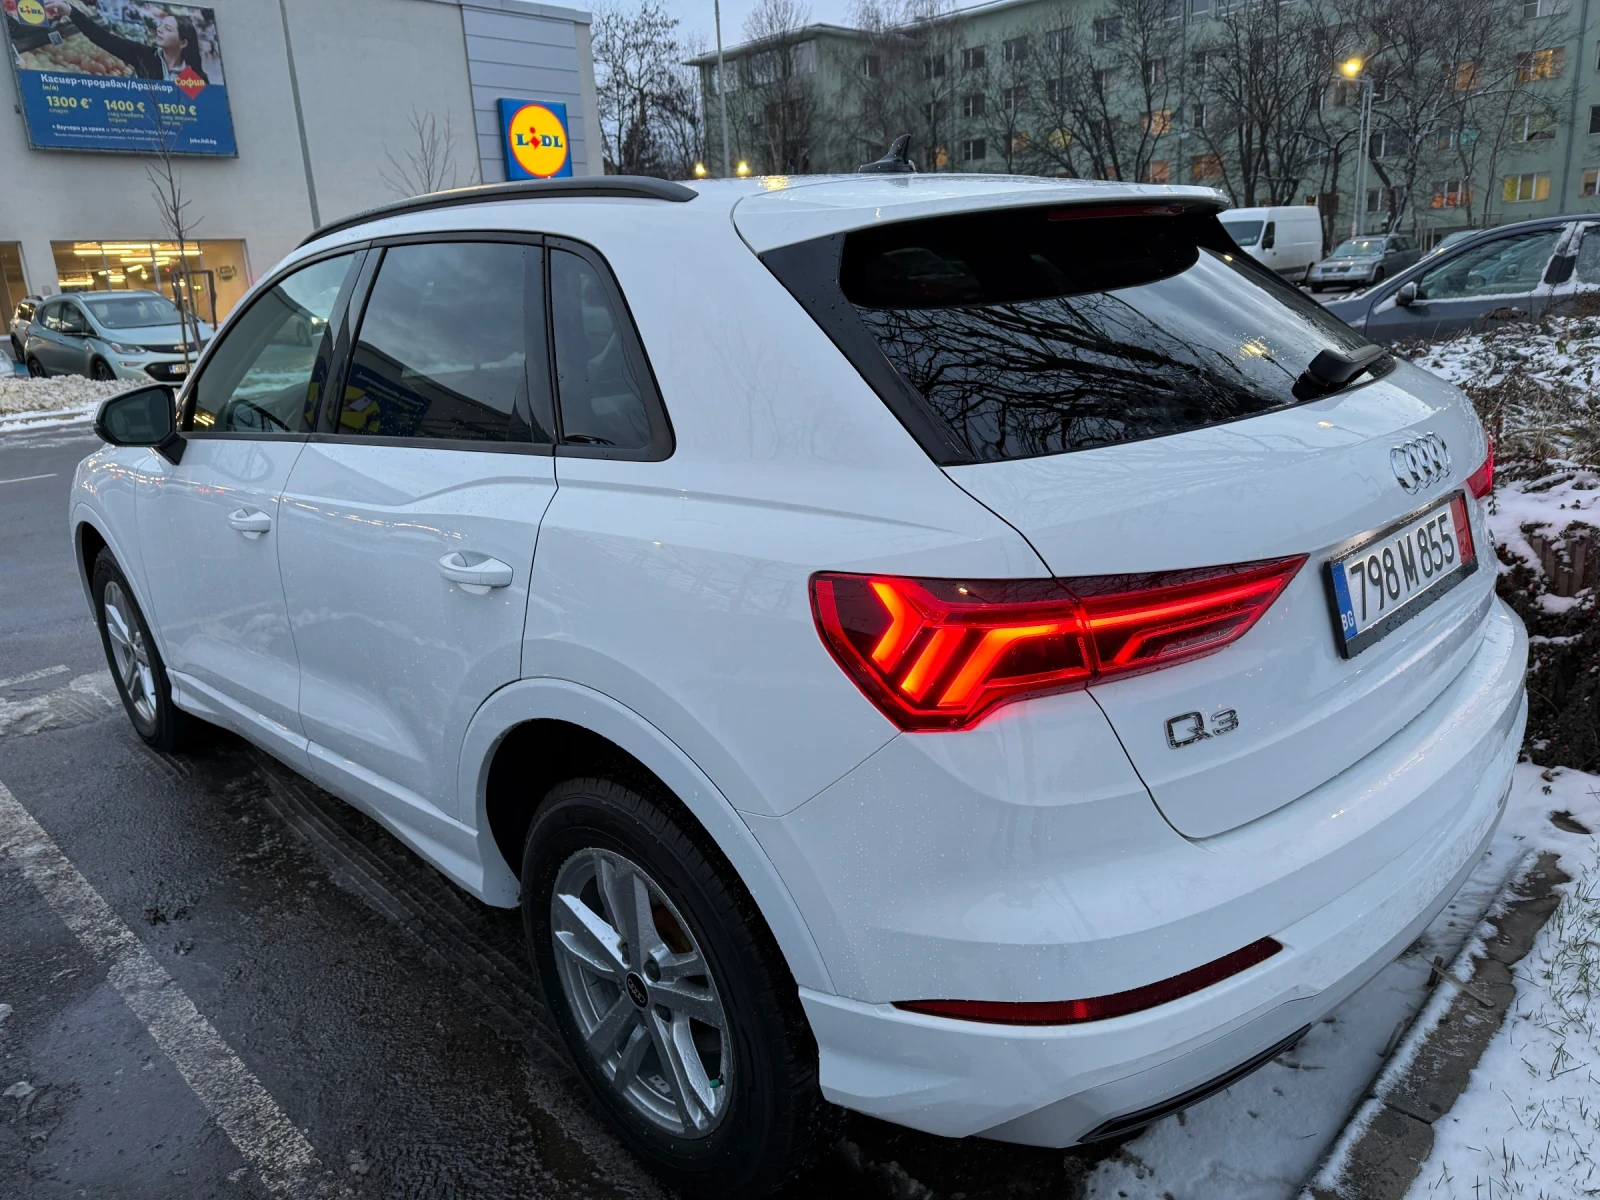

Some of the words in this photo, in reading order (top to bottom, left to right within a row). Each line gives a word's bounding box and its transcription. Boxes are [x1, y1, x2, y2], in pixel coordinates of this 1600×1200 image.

[174, 77, 205, 88] София
[46, 95, 77, 108] 1300
[104, 99, 134, 112] 1400
[137, 101, 145, 113] €
[158, 103, 186, 115] 1500
[189, 105, 197, 115] €
[1341, 610, 1355, 631] BG
[1163, 708, 1239, 750] Q3
